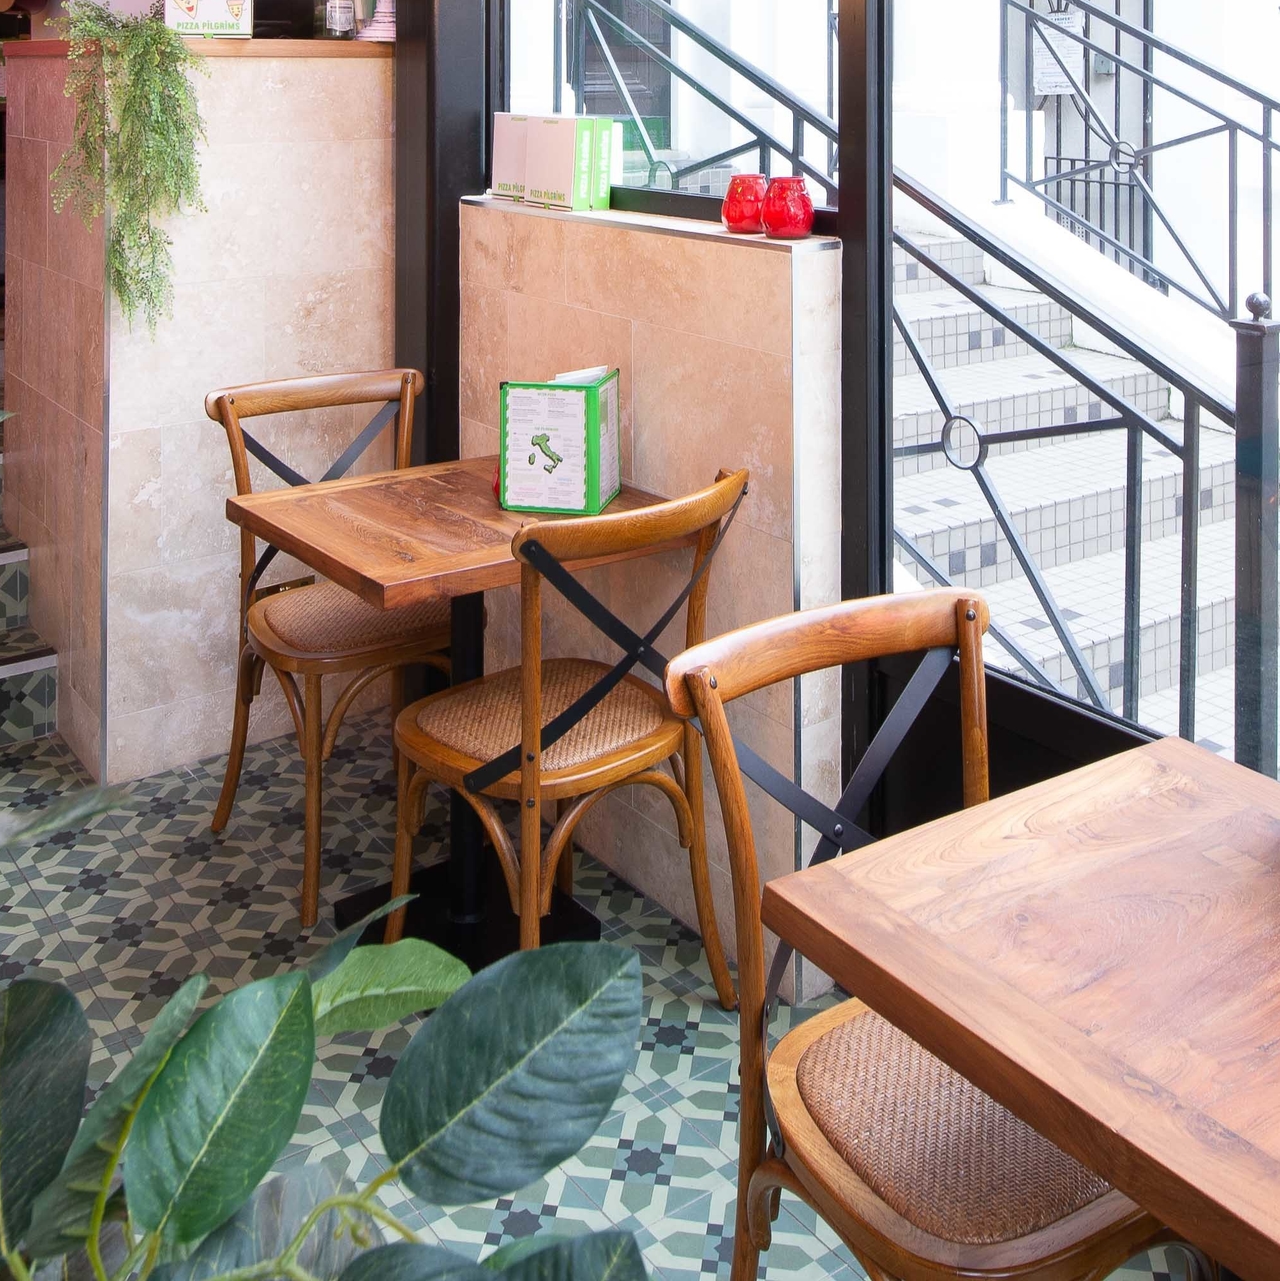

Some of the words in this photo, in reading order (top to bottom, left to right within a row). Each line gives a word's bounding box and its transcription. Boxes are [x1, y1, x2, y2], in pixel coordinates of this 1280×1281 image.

[176, 21, 199, 30] PIZZA
[202, 20, 241, 30] PiLGRiMS
[581, 130, 591, 171] PiLGRiMS
[600, 130, 611, 171] PiLGRiMS
[498, 183, 511, 193] PIZZA
[512, 182, 525, 193] PiLGR
[530, 189, 543, 199] PIZZA
[543, 189, 566, 202] PiLGRiMS
[580, 173, 589, 198] PIZZA
[598, 173, 608, 198] PIZZA
